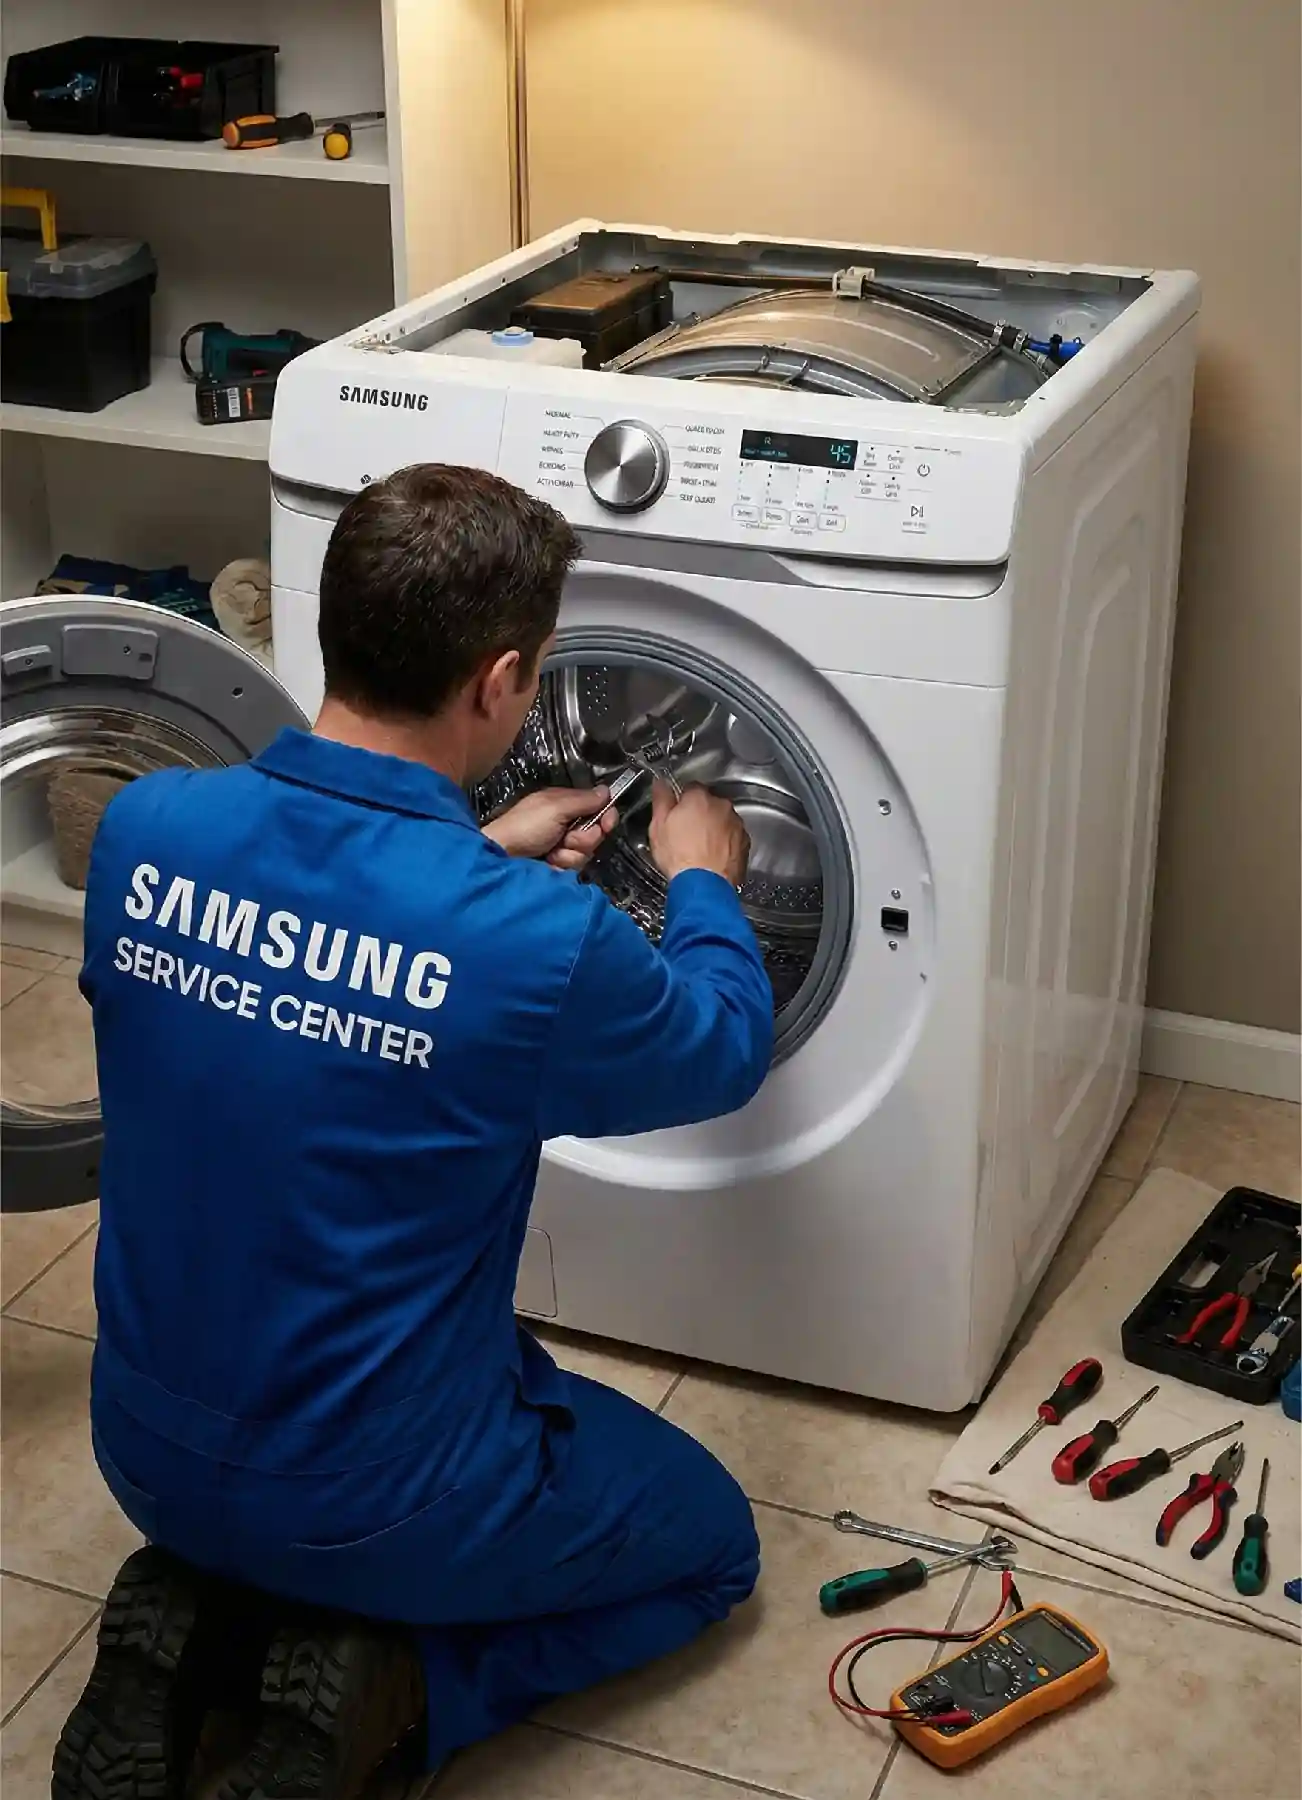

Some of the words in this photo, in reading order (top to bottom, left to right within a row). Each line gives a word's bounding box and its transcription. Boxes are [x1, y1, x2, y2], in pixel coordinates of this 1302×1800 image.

[339, 385, 429, 411] SAMSUNG
[830, 444, 851, 464] 45
[125, 863, 452, 1009] SAMSUNG
[113, 936, 262, 1019] SERVICE
[270, 994, 434, 1068] CENTER
